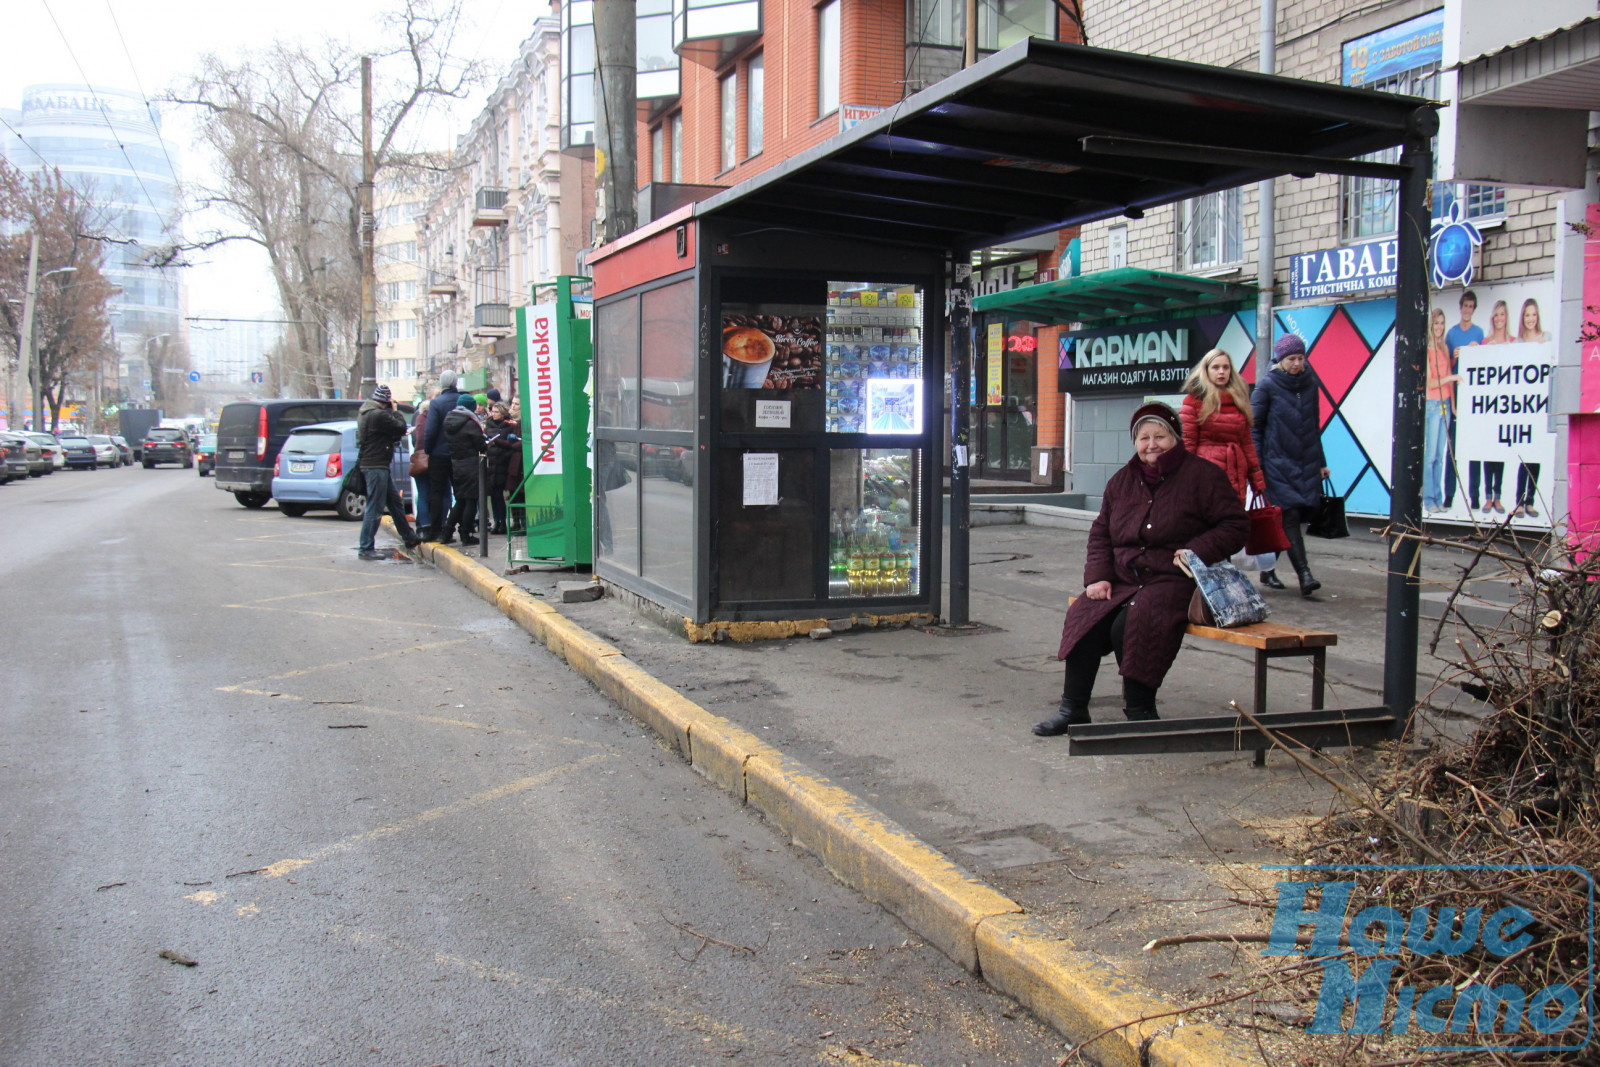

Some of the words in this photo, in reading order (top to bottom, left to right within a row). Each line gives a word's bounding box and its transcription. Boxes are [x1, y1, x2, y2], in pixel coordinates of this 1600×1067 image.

[1349, 45, 1369, 70] 10
[1380, 36, 1420, 60] ЗАБОТОЙ
[1428, 29, 1444, 46] ВА
[1299, 279, 1364, 297] ТУРИСТИЧНА
[797, 337, 819, 348] Coffee
[1075, 328, 1188, 369] KARMAN
[1082, 371, 1119, 386] МАГАЗИН
[1120, 370, 1147, 386] ОДЯГУ
[1147, 369, 1160, 382] ТА
[1160, 367, 1190, 382] ВЗУТТЯ
[1498, 423, 1532, 448] ЦІН
